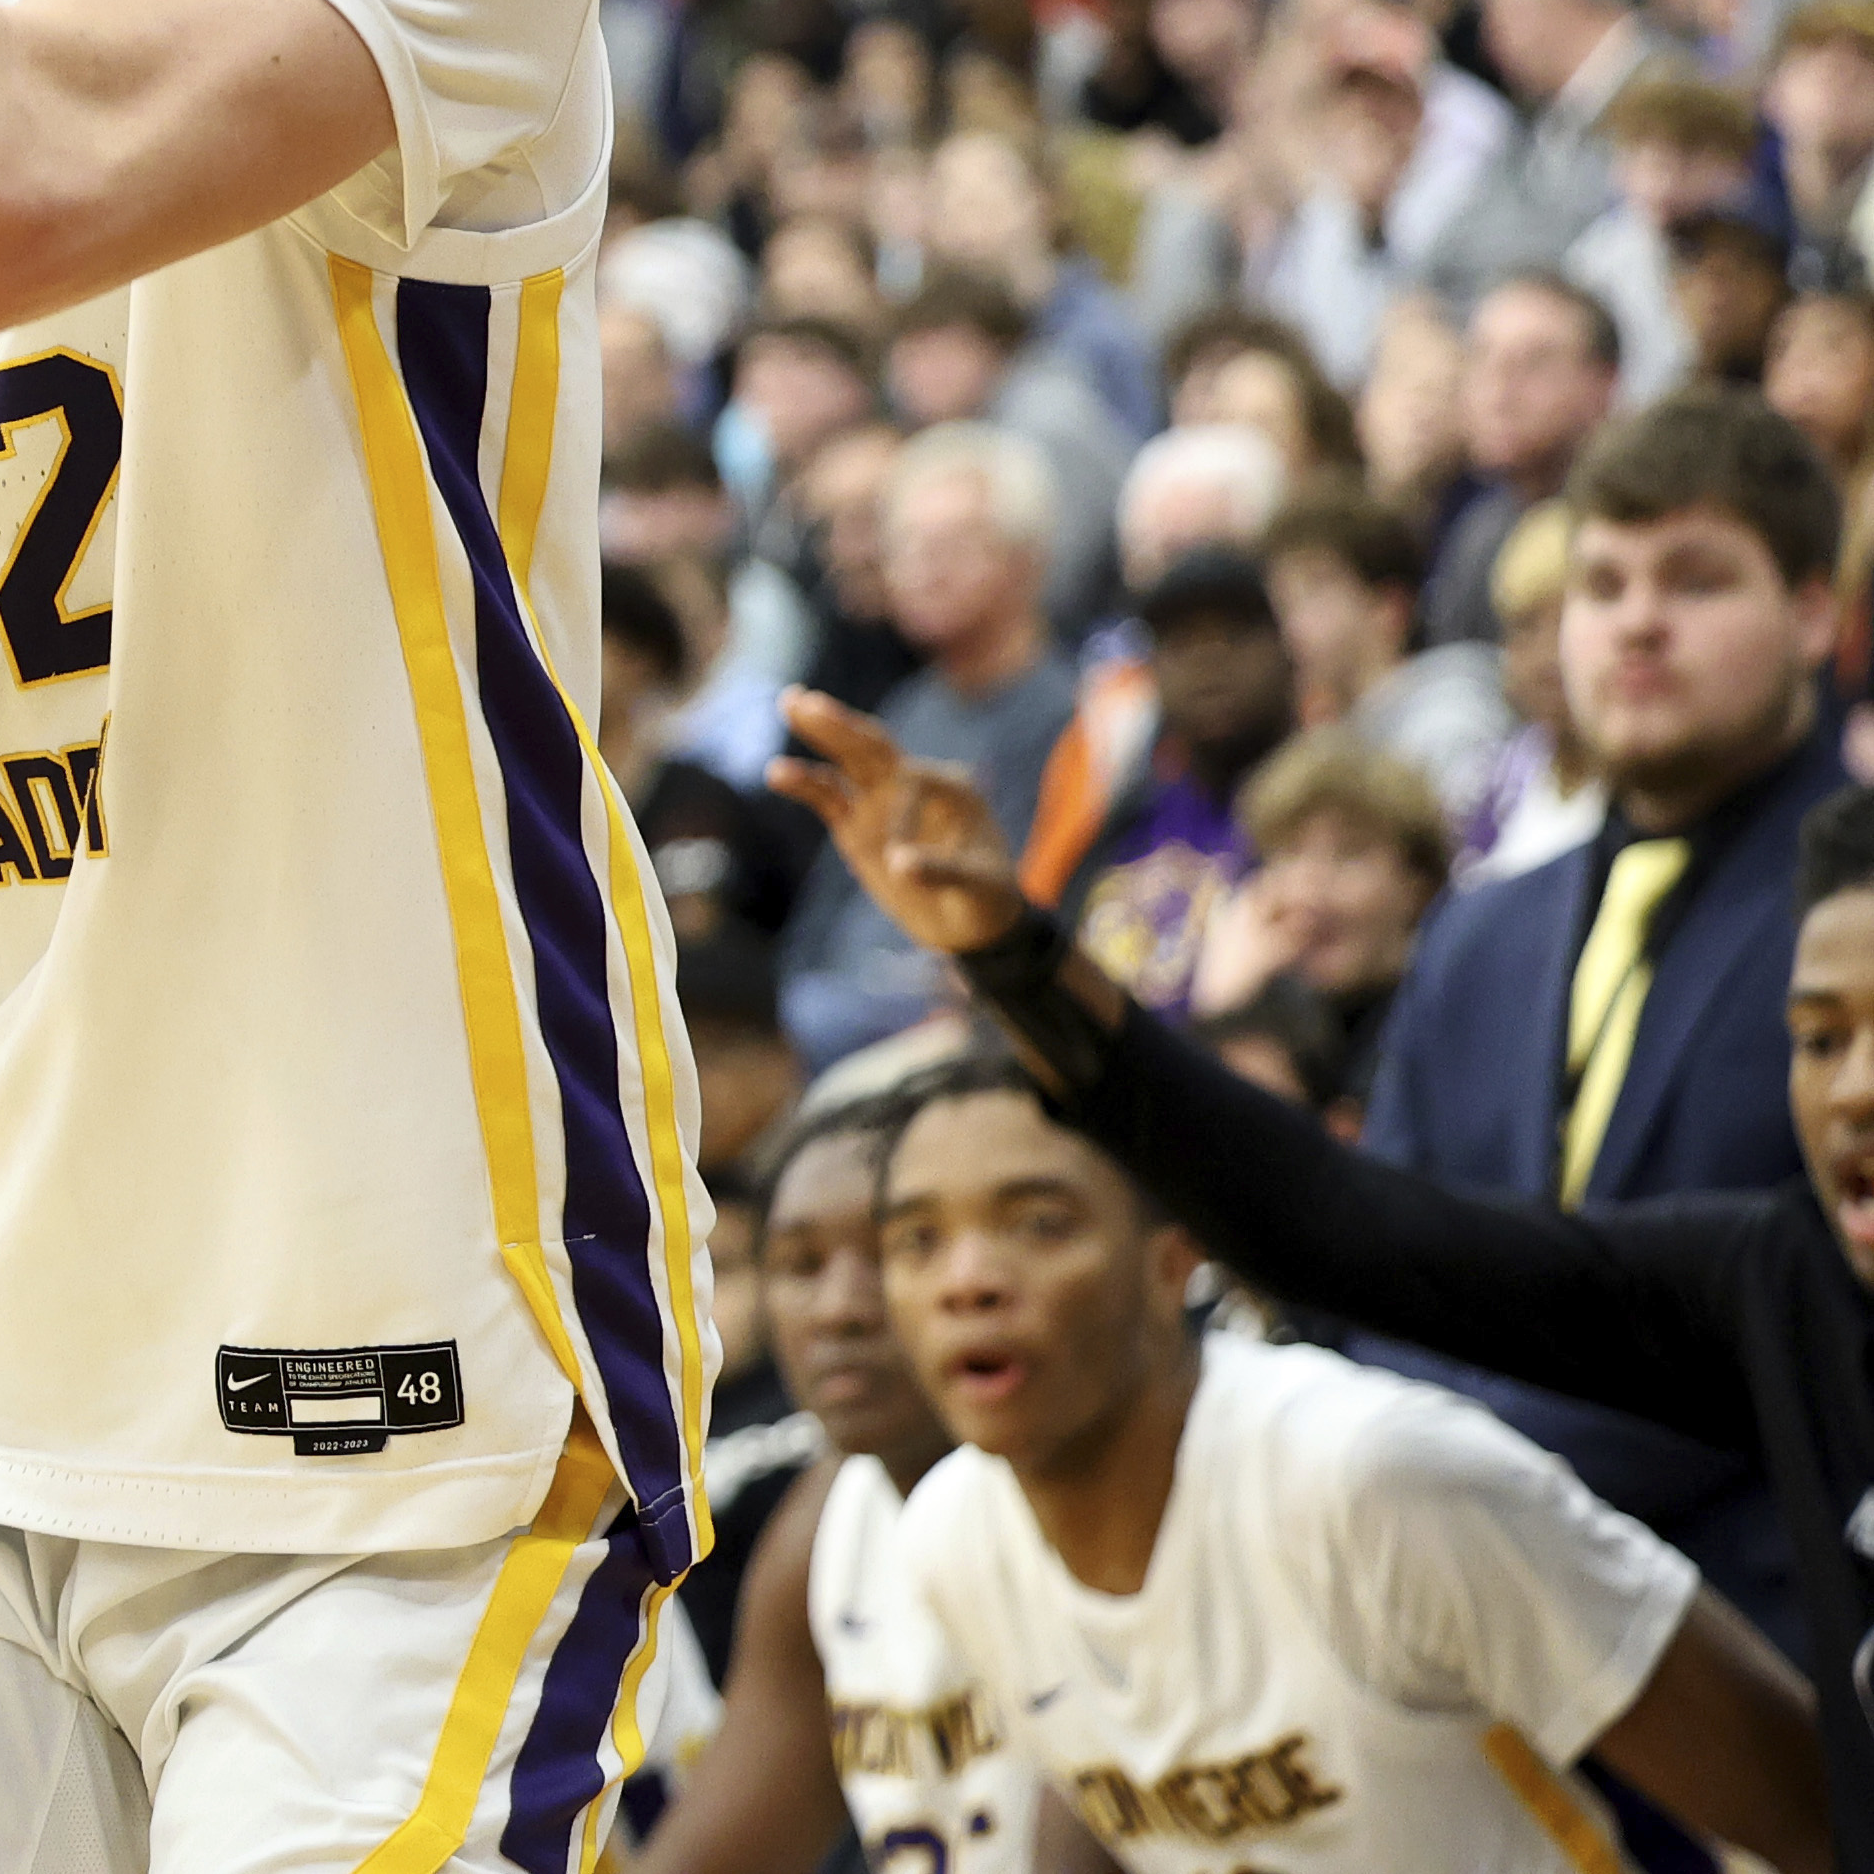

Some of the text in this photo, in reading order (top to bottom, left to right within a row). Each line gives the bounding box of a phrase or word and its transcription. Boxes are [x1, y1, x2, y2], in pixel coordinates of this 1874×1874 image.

[286, 1358, 375, 1373] ENGINEERED
[397, 1371, 441, 1405] 48
[229, 1400, 279, 1413] TEAM
